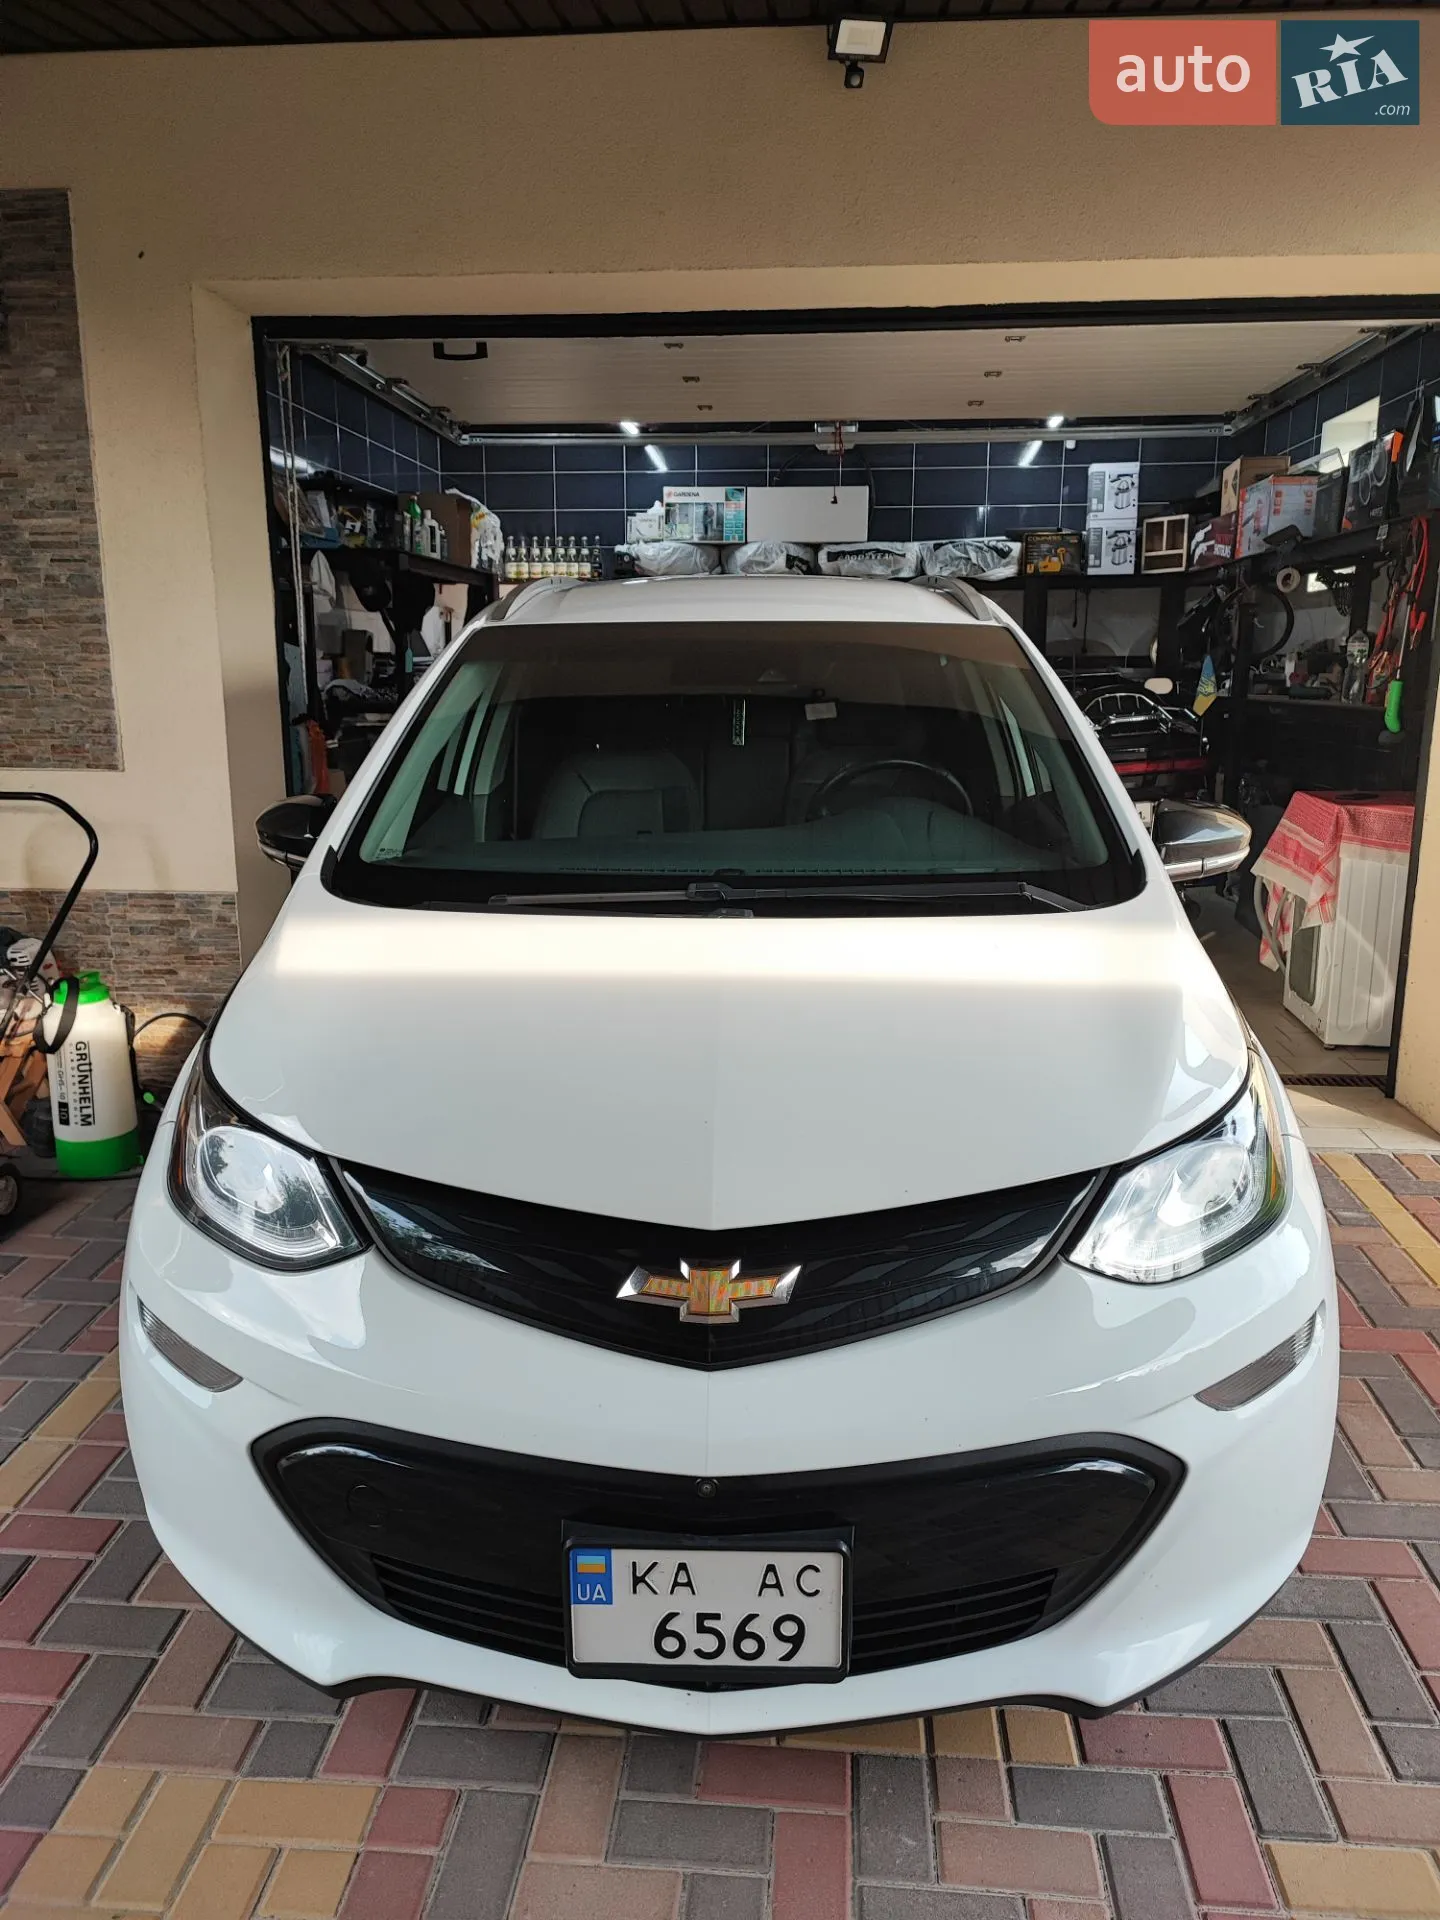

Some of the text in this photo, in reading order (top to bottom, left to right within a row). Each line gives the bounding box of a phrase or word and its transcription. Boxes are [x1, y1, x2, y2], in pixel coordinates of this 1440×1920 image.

[75, 1041, 93, 1127] GRÜNHELM
[577, 1583, 607, 1602] UA
[631, 1560, 822, 1598] KA AC
[653, 1611, 807, 1662] 6569
